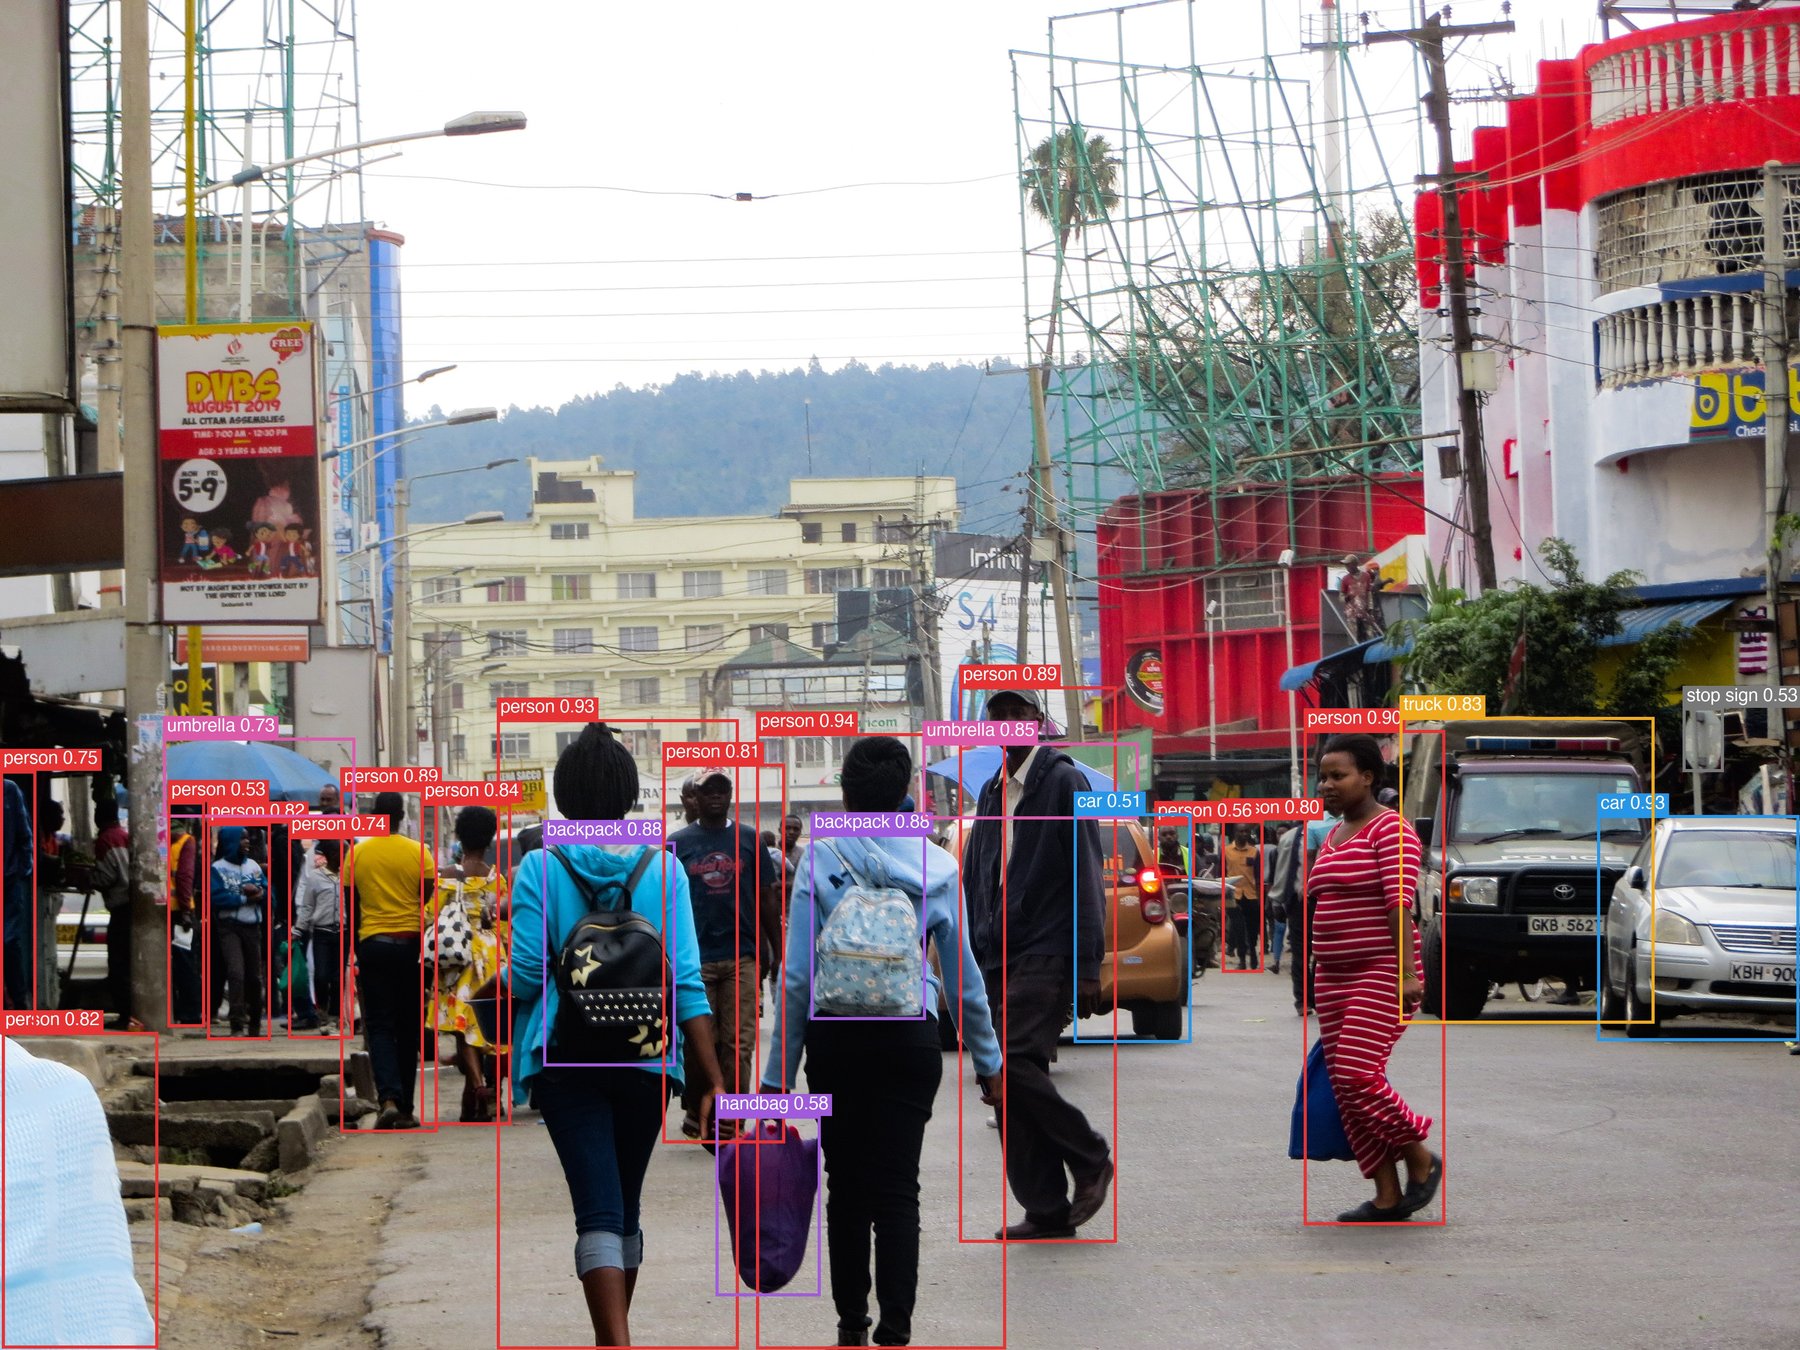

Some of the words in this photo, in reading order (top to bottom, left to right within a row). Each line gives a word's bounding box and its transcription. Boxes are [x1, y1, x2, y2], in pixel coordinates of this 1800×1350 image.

[272, 338, 301, 348] FREE
[186, 368, 281, 405] DVBS
[187, 401, 240, 414] AUGUST
[244, 400, 281, 413] 2019
[182, 418, 197, 426] ALL
[199, 417, 227, 425] CITAM
[229, 415, 286, 425] ASSEMBLIES
[233, 430, 247, 438] AM
[958, 591, 998, 632] S4
[1500, 854, 1625, 862] POLICE
[1532, 918, 1559, 932] GKB
[1732, 964, 1764, 980] KBH
